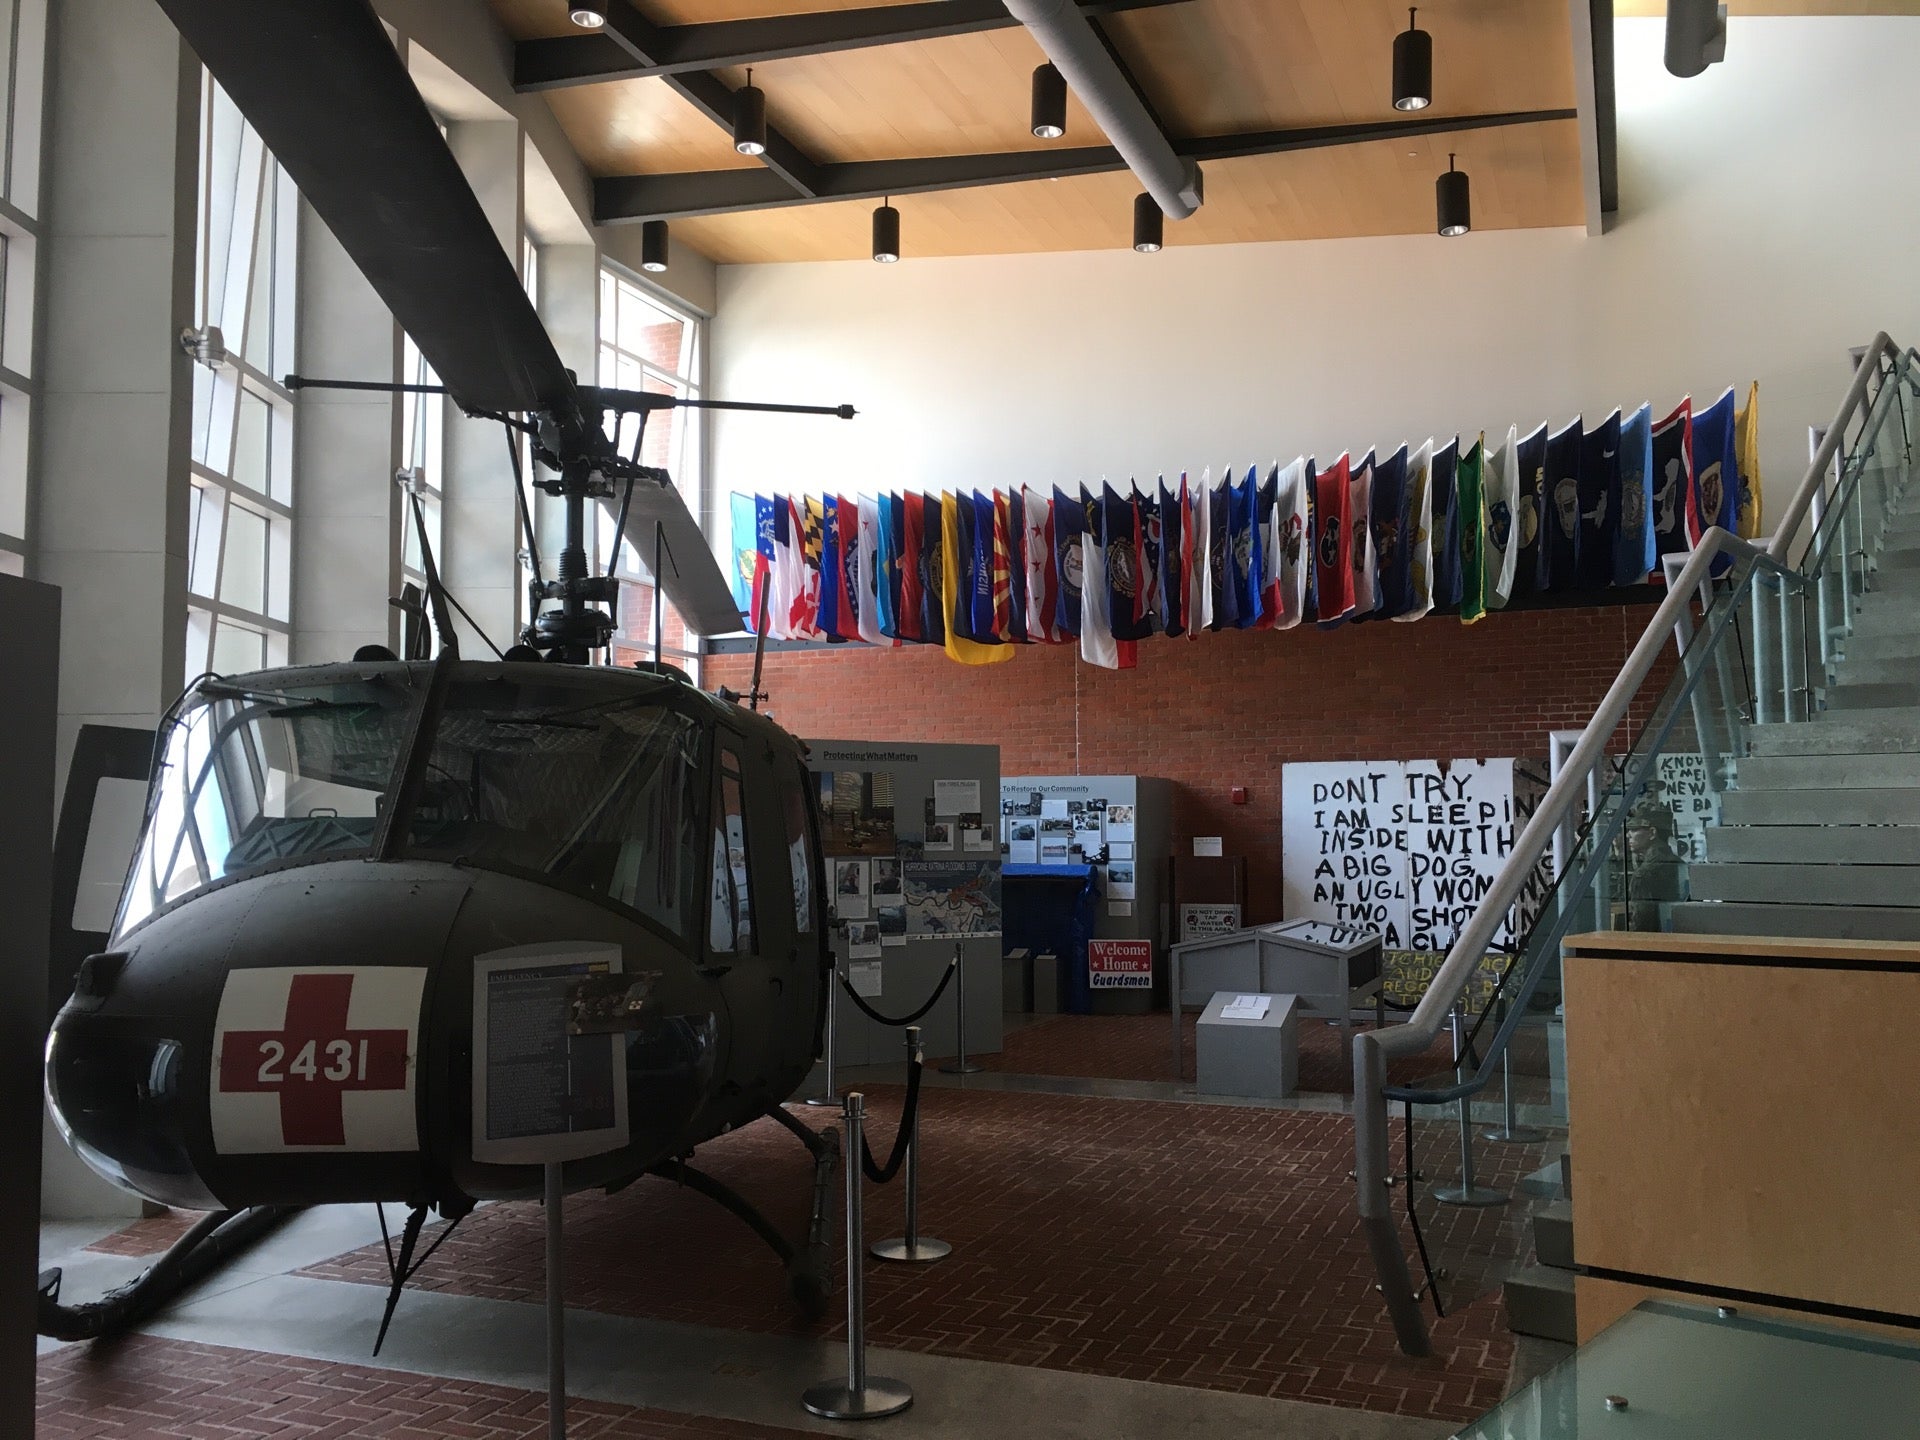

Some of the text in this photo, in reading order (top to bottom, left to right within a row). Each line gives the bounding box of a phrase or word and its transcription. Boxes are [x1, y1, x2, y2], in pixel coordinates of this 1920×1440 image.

[824, 751, 918, 762] Protecting What Matters
[1050, 785, 1088, 793] Community
[1313, 772, 1388, 804] DONT
[1315, 811, 1325, 829] I
[1334, 808, 1371, 829] AM
[1320, 825, 1515, 858] INSIDE WITH
[1314, 859, 1335, 879] A
[1343, 851, 1392, 880] BIG
[1313, 882, 1345, 904] AN
[1357, 878, 1424, 904] UGLY
[1336, 903, 1388, 923] TWO
[1092, 943, 1147, 956] Welcome
[1103, 956, 1138, 970] Home
[1093, 973, 1149, 986] Guardsmen
[257, 1039, 368, 1082] 2431
